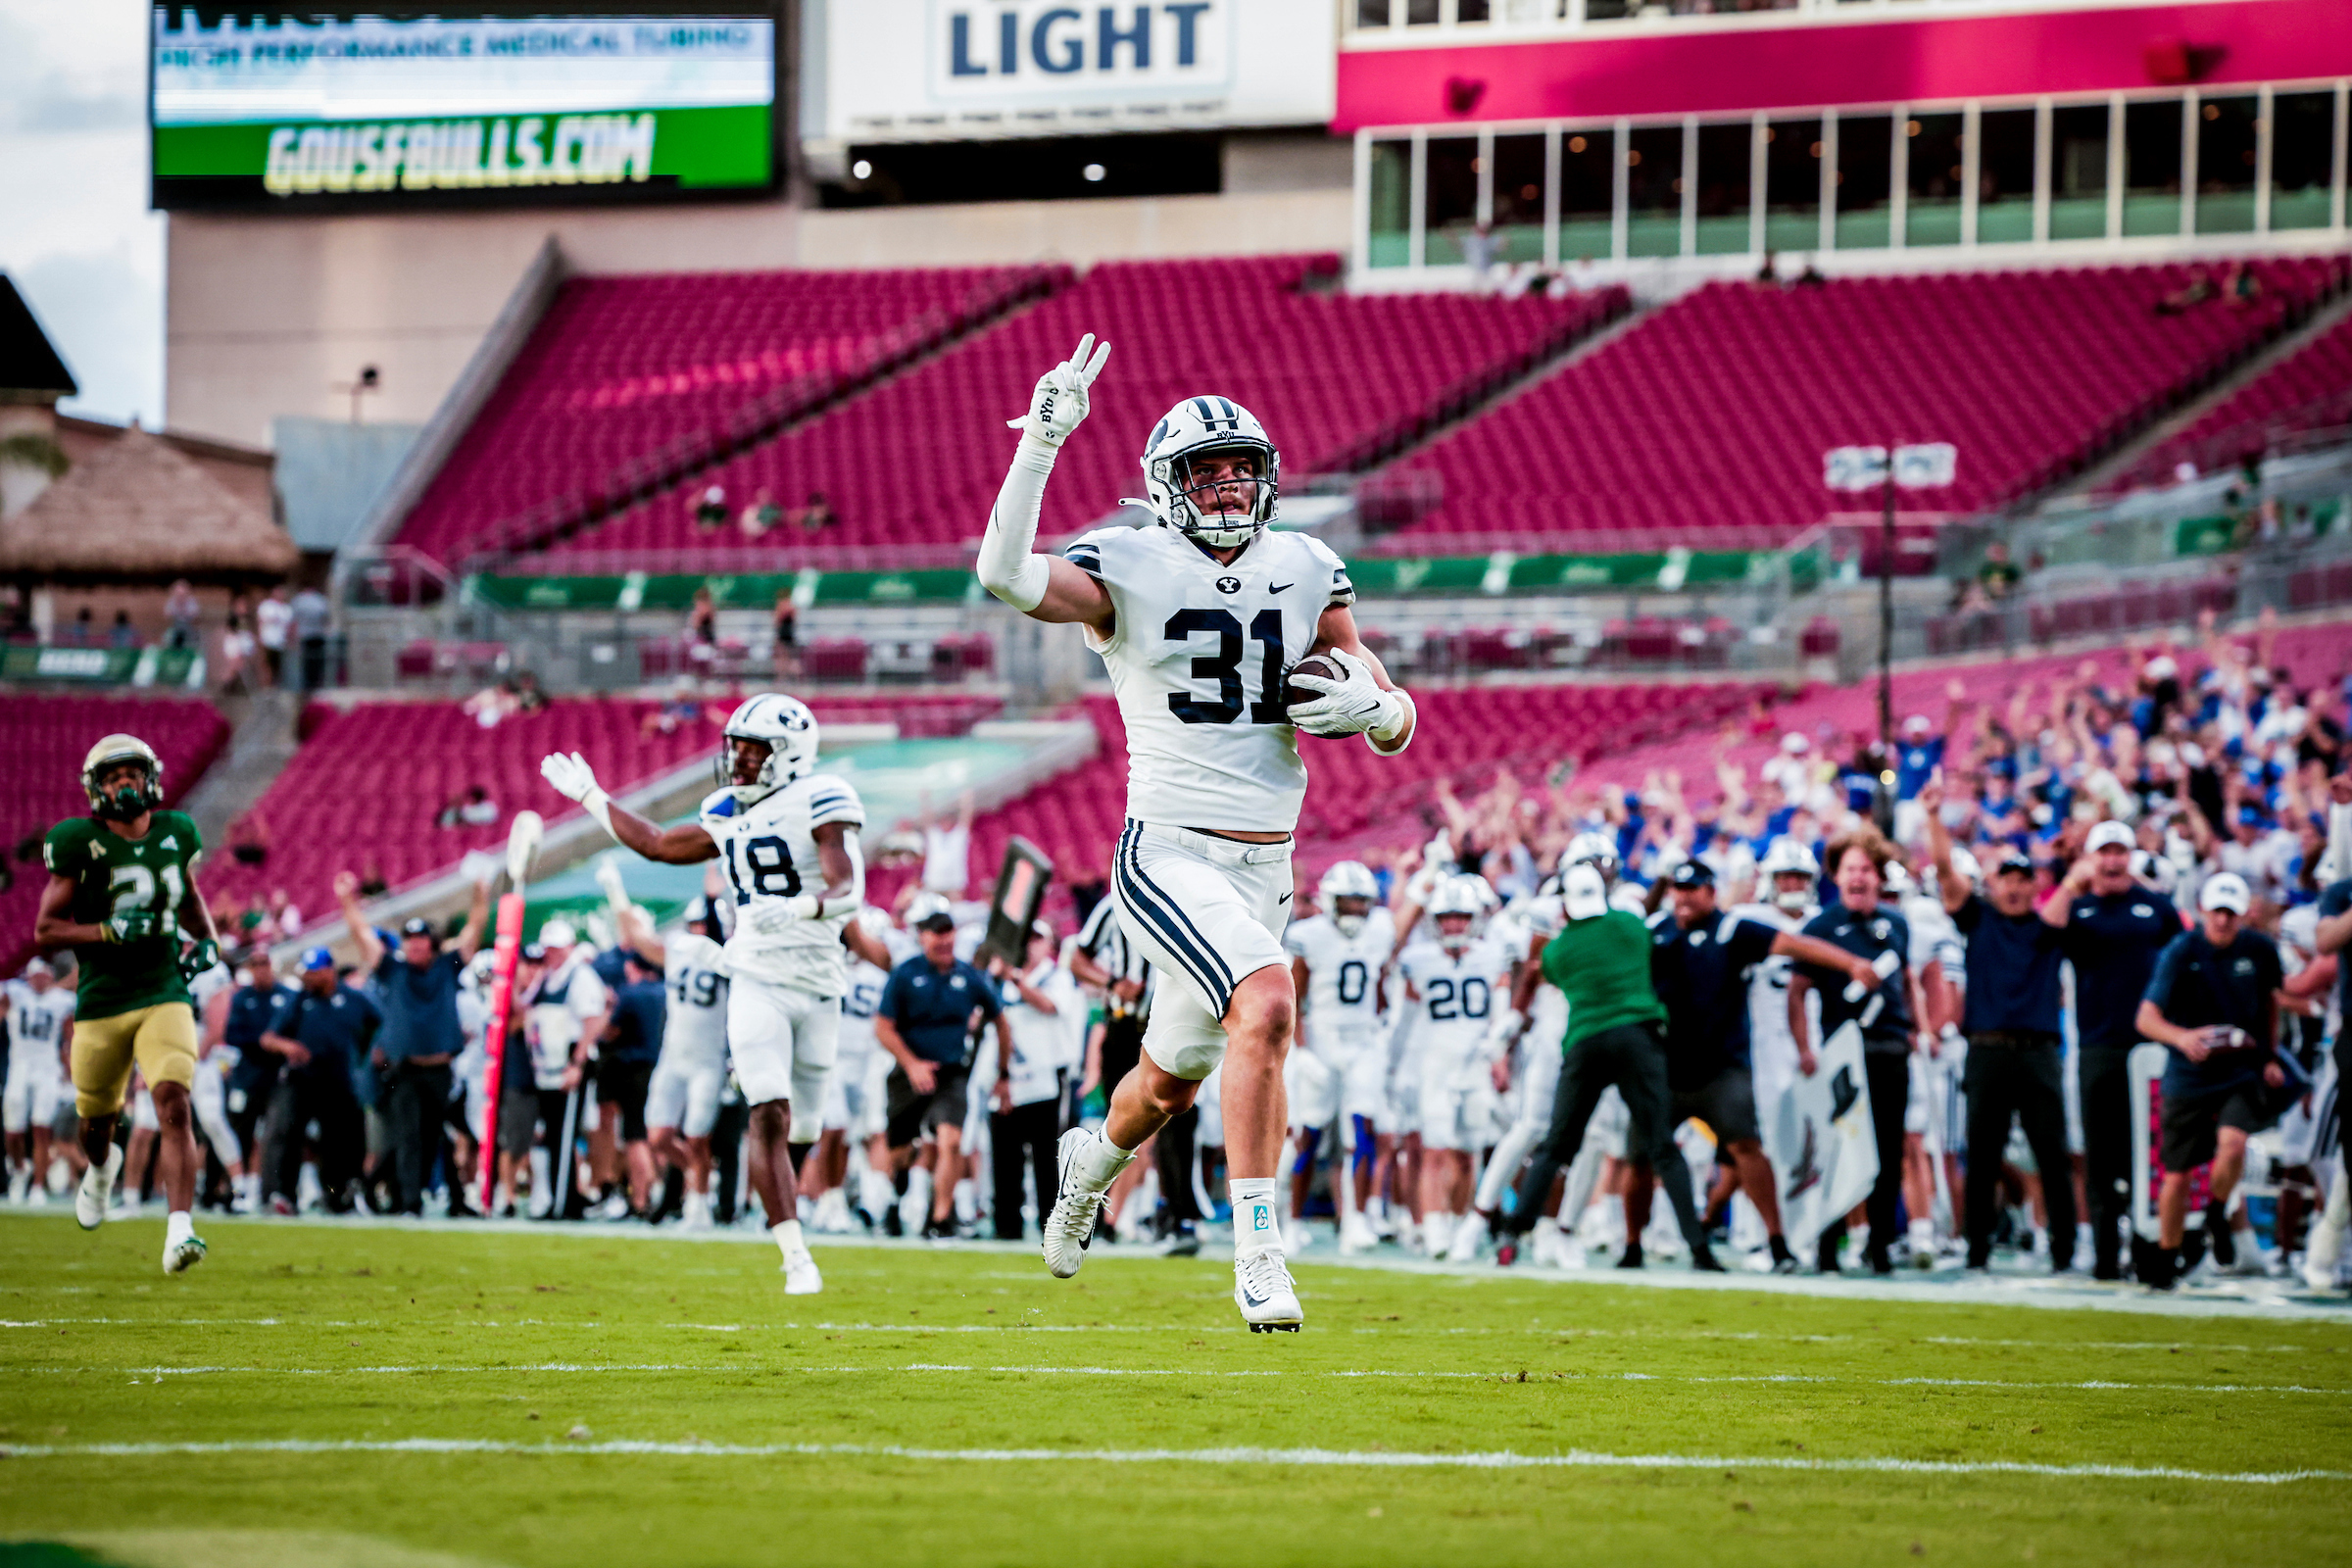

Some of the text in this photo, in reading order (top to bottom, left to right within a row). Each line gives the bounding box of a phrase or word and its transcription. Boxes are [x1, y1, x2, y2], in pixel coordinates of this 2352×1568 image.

[951, 3, 1210, 76] LIGHT
[1040, 397, 1054, 423] BYU
[1163, 609, 1295, 723] 31
[110, 862, 184, 936] 21
[725, 835, 802, 906] 18
[1339, 960, 1368, 1004] 0
[1428, 977, 1490, 1020] 20
